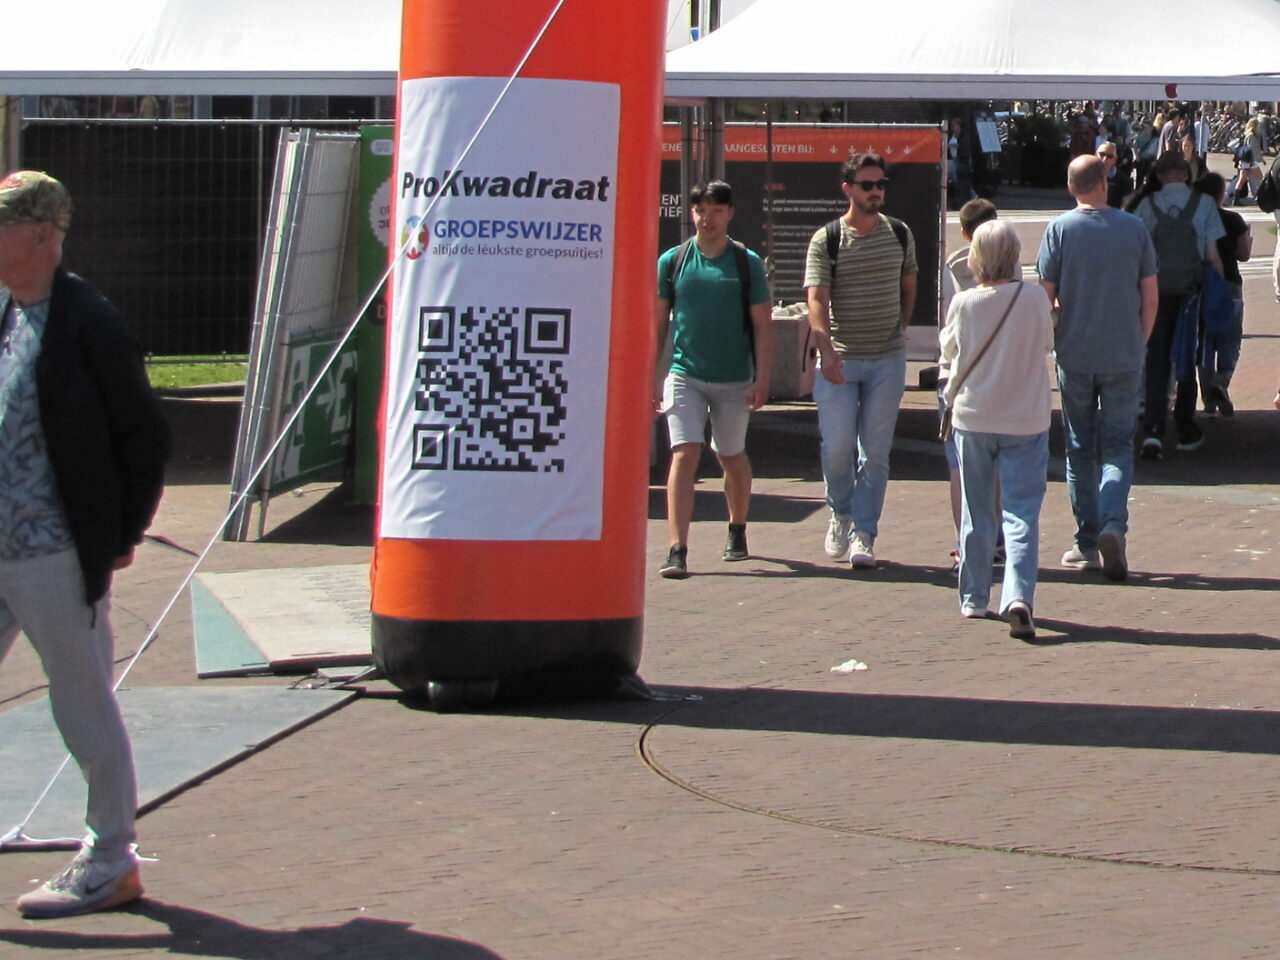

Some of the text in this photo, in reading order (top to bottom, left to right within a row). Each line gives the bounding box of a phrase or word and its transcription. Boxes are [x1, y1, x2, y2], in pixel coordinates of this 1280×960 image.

[402, 170, 610, 201] ProKwadraat
[434, 219, 602, 242] GROEPSWIJZER
[432, 244, 459, 257] altijd
[461, 244, 475, 255] de
[526, 246, 604, 259] groepsuitjes!
